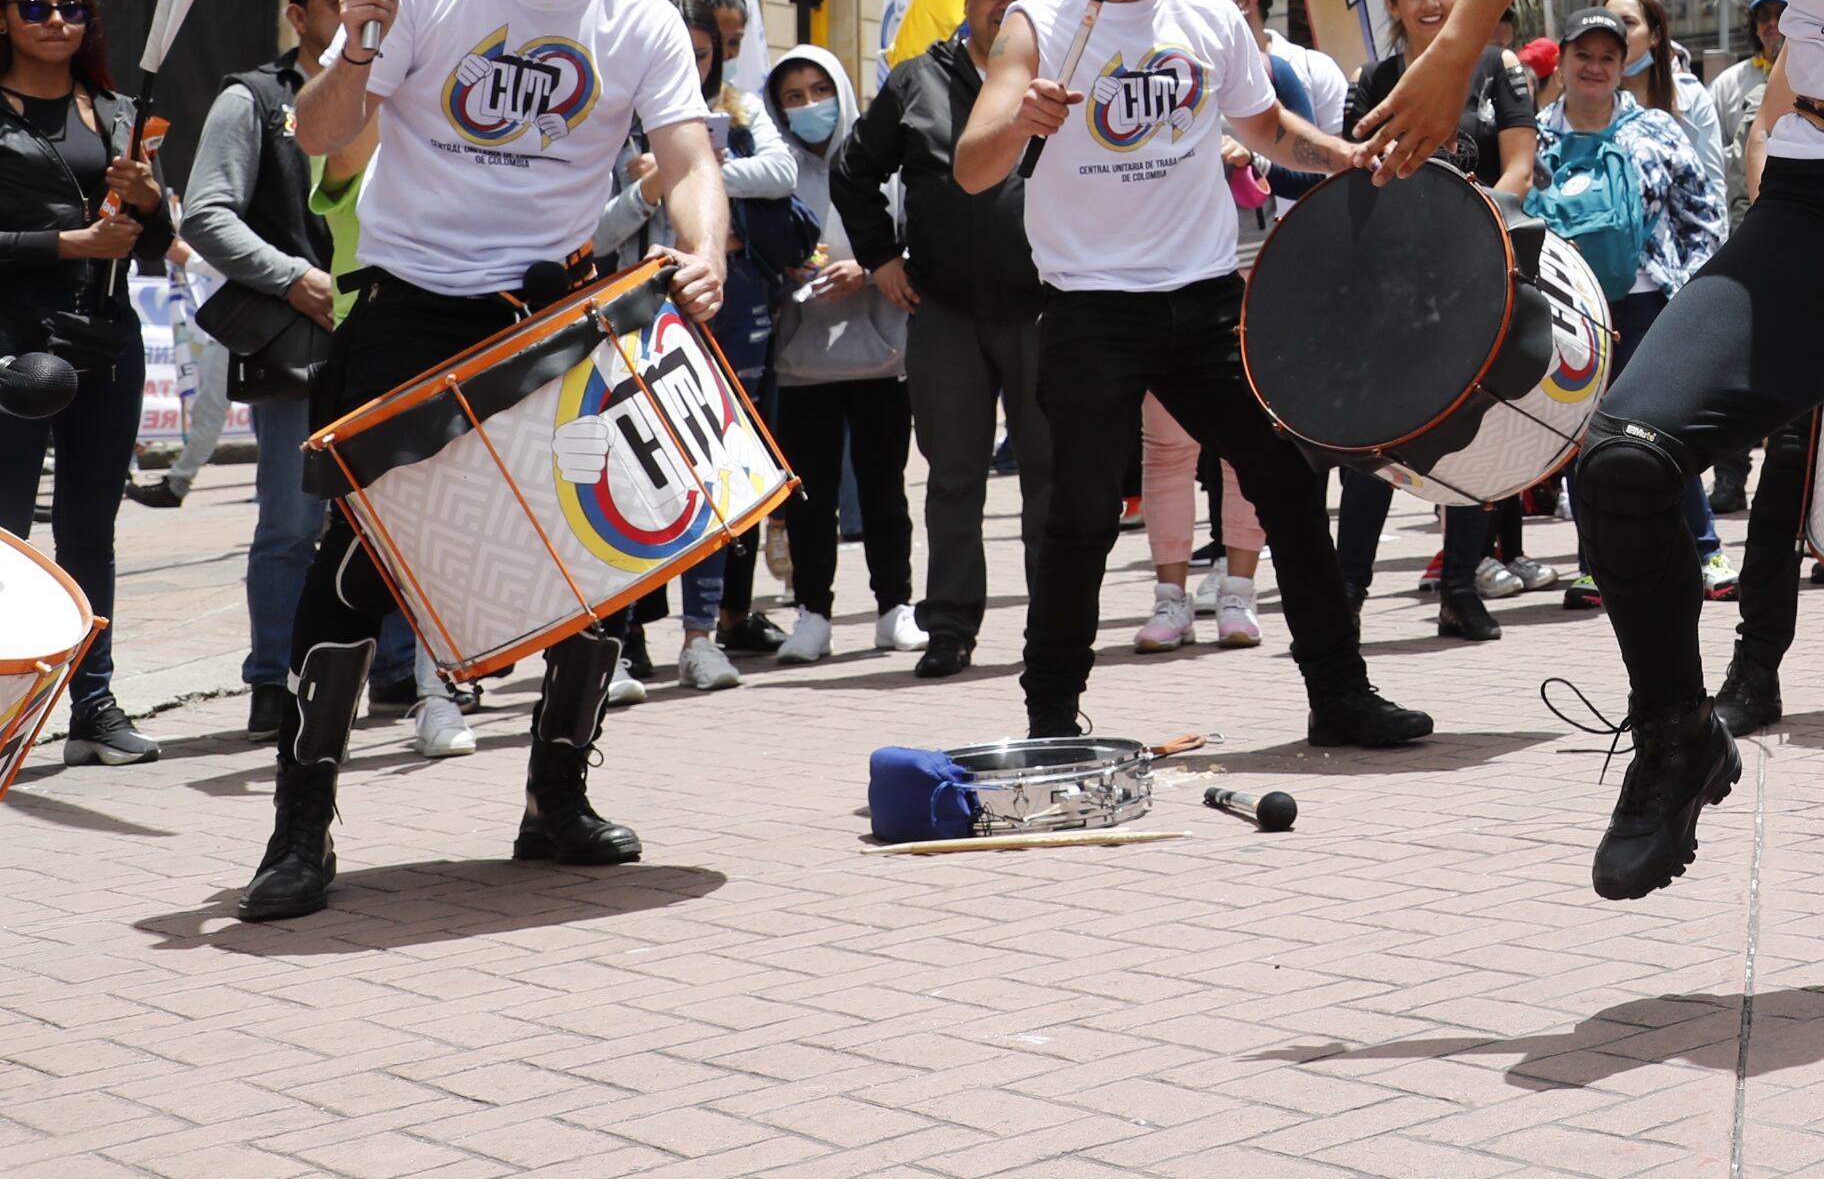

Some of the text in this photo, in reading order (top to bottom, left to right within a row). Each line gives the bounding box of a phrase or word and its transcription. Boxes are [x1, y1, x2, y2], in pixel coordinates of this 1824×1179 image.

[480, 56, 558, 124] CUT
[1119, 69, 1178, 125] CUT
[475, 155, 486, 164] DE
[488, 155, 530, 168] COLOMBIA
[1079, 165, 1110, 174] CENTRAL
[1111, 163, 1144, 172] UNITARIA
[1145, 161, 1153, 169] DE
[1121, 170, 1167, 182] DE COLOMBIA
[600, 350, 730, 509] CUT
